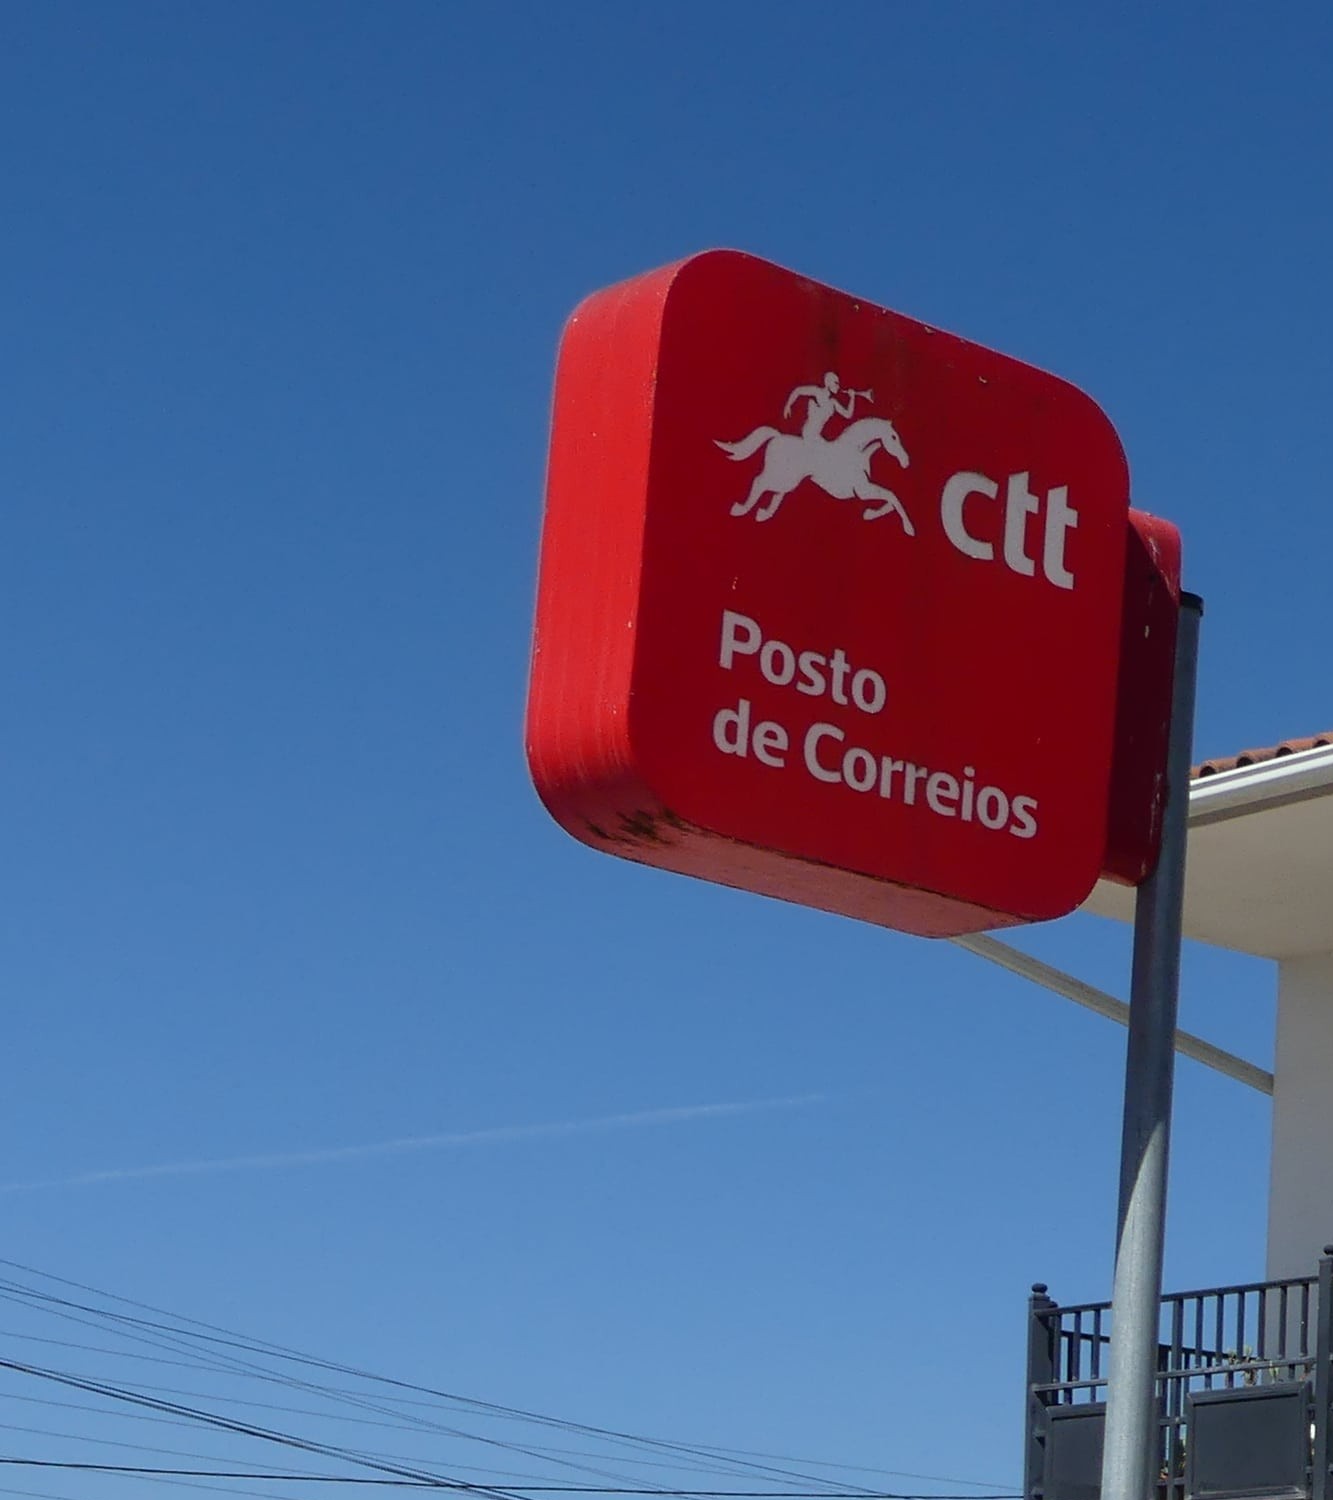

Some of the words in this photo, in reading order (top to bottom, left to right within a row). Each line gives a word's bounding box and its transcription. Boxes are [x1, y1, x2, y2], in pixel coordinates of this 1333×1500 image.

[940, 471, 1078, 589] ctt
[718, 608, 887, 714] Posto
[712, 699, 788, 768] de
[803, 723, 1038, 839] Correios
